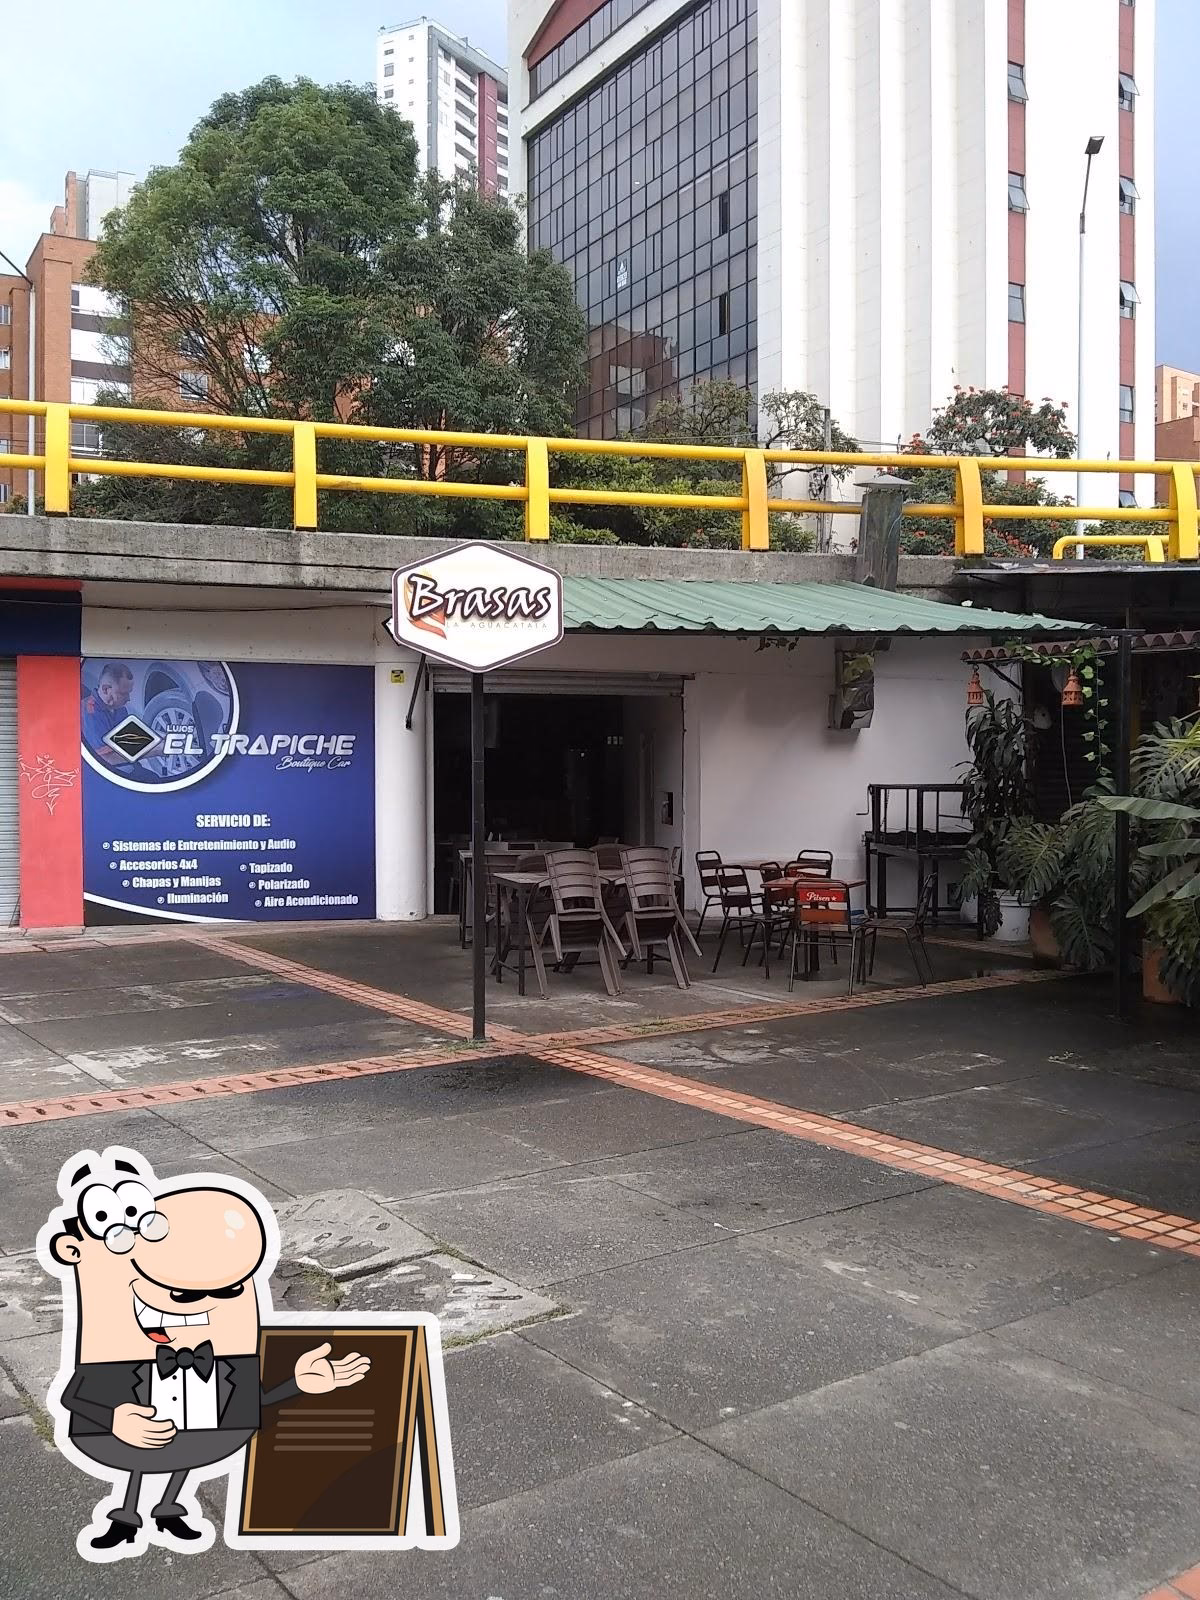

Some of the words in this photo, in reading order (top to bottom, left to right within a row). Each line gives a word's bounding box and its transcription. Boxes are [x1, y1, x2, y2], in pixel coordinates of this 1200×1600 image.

[407, 573, 551, 619] Brasas
[166, 725, 194, 733] LUJOS
[163, 733, 203, 755] EL
[210, 734, 356, 755] TRAPICHE
[275, 756, 326, 773] Boutique
[327, 756, 351, 769] Car
[196, 814, 251, 828] SERVICIO
[252, 814, 271, 827] DE:
[112, 840, 161, 852] Sistemas
[162, 840, 176, 851] de
[177, 839, 259, 851] Entretenimiento
[260, 840, 267, 850] y
[267, 838, 296, 849] Audio
[119, 859, 178, 871] Accesorios
[179, 858, 198, 870] 4x4
[249, 862, 293, 874] Tapizado
[132, 877, 171, 888] Chapas
[172, 879, 180, 888] y
[180, 875, 221, 887] Manijas
[258, 879, 310, 890] Polarizado
[167, 892, 229, 904] Iluminación
[264, 895, 285, 907] Aire
[285, 894, 359, 906] Acondicionado
[806, 891, 830, 902] Pilsen
